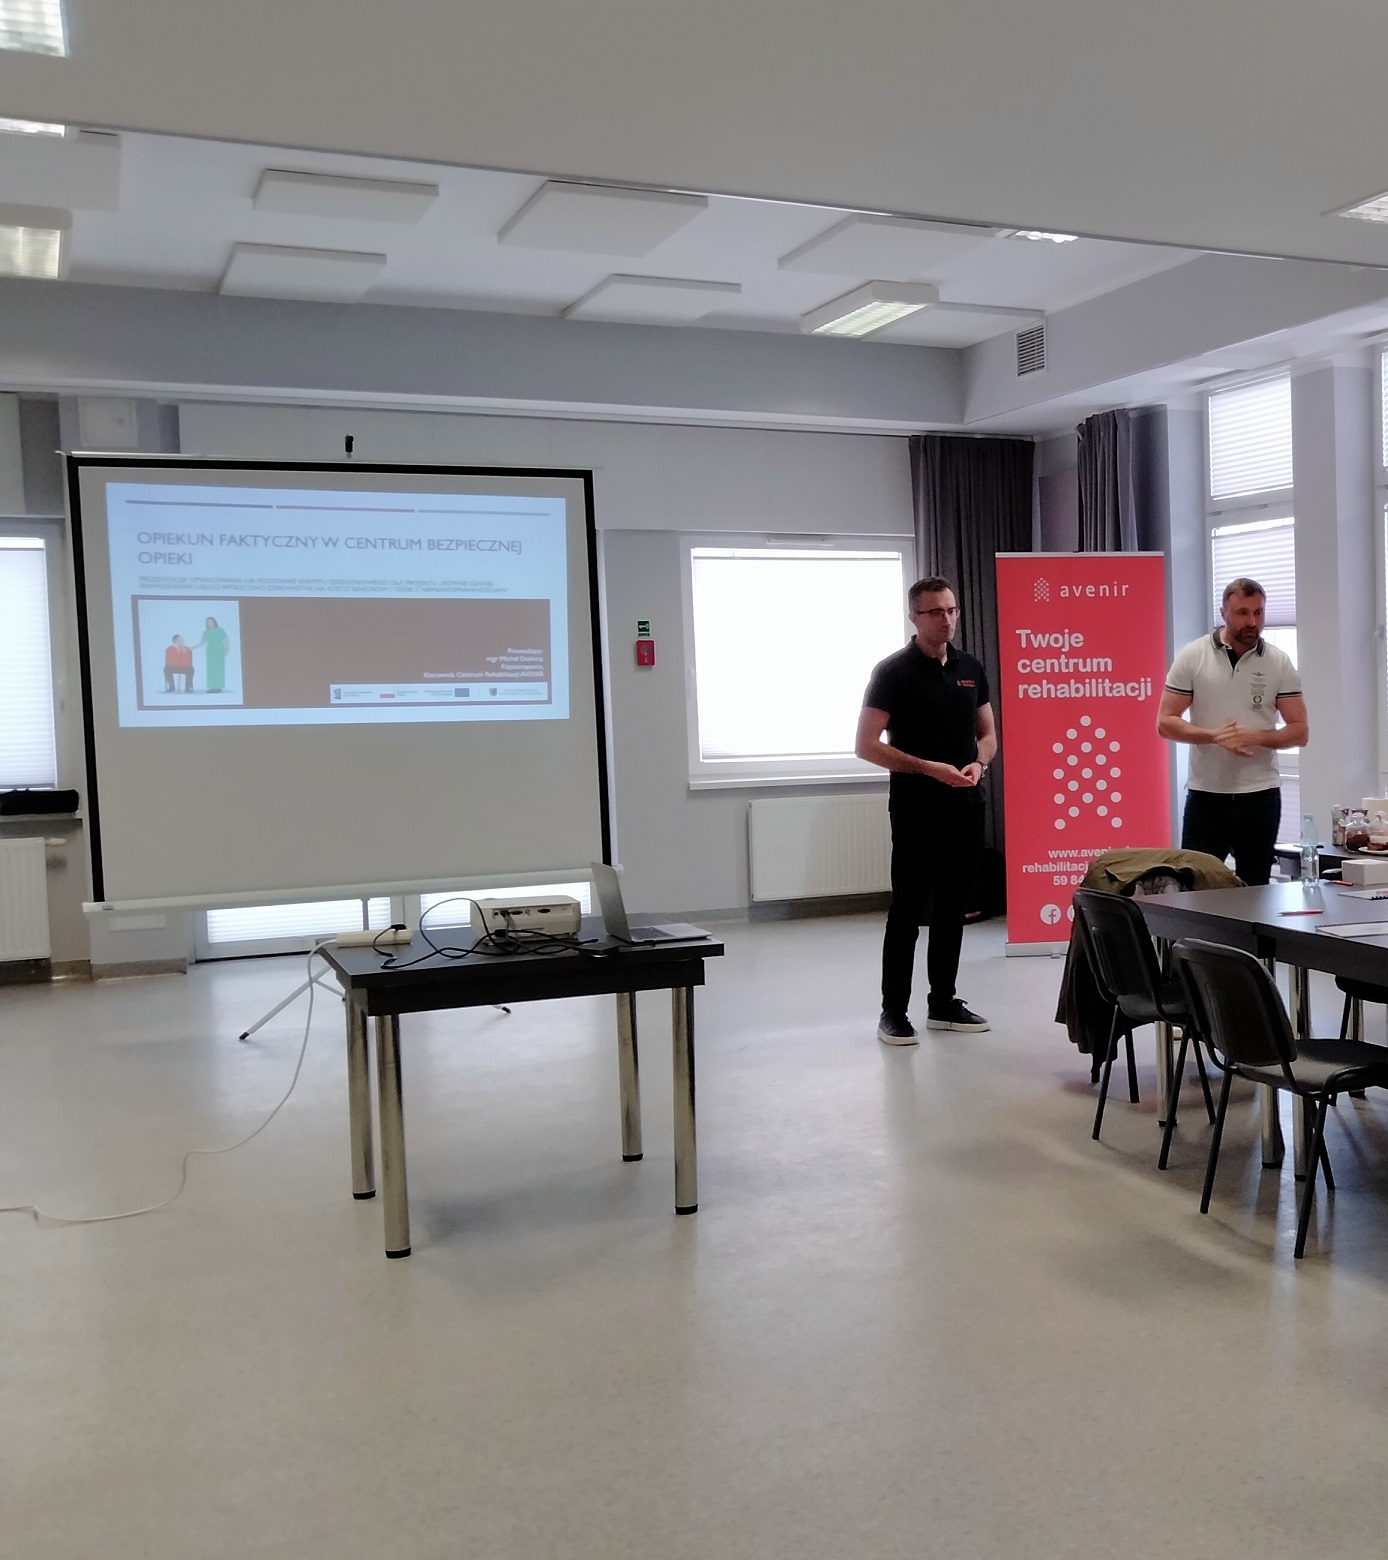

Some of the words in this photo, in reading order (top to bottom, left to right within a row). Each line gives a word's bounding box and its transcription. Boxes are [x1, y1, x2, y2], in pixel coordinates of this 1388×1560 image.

[137, 531, 214, 547] OPIEKUN
[219, 534, 319, 549] FAKTYCZNY
[321, 536, 340, 549] W
[344, 537, 422, 551] CENTRUM
[427, 538, 522, 555] BEZPIECZNEJ
[138, 551, 193, 566] OPIEKI
[1060, 580, 1129, 598] avenir
[1015, 628, 1084, 652] Twoje
[1017, 654, 1113, 674] centrum
[1018, 677, 1152, 701] rehabilitacji
[1022, 860, 1089, 873] rehabilitacj
[1053, 875, 1068, 885] 59
[1070, 874, 1085, 885] 84
